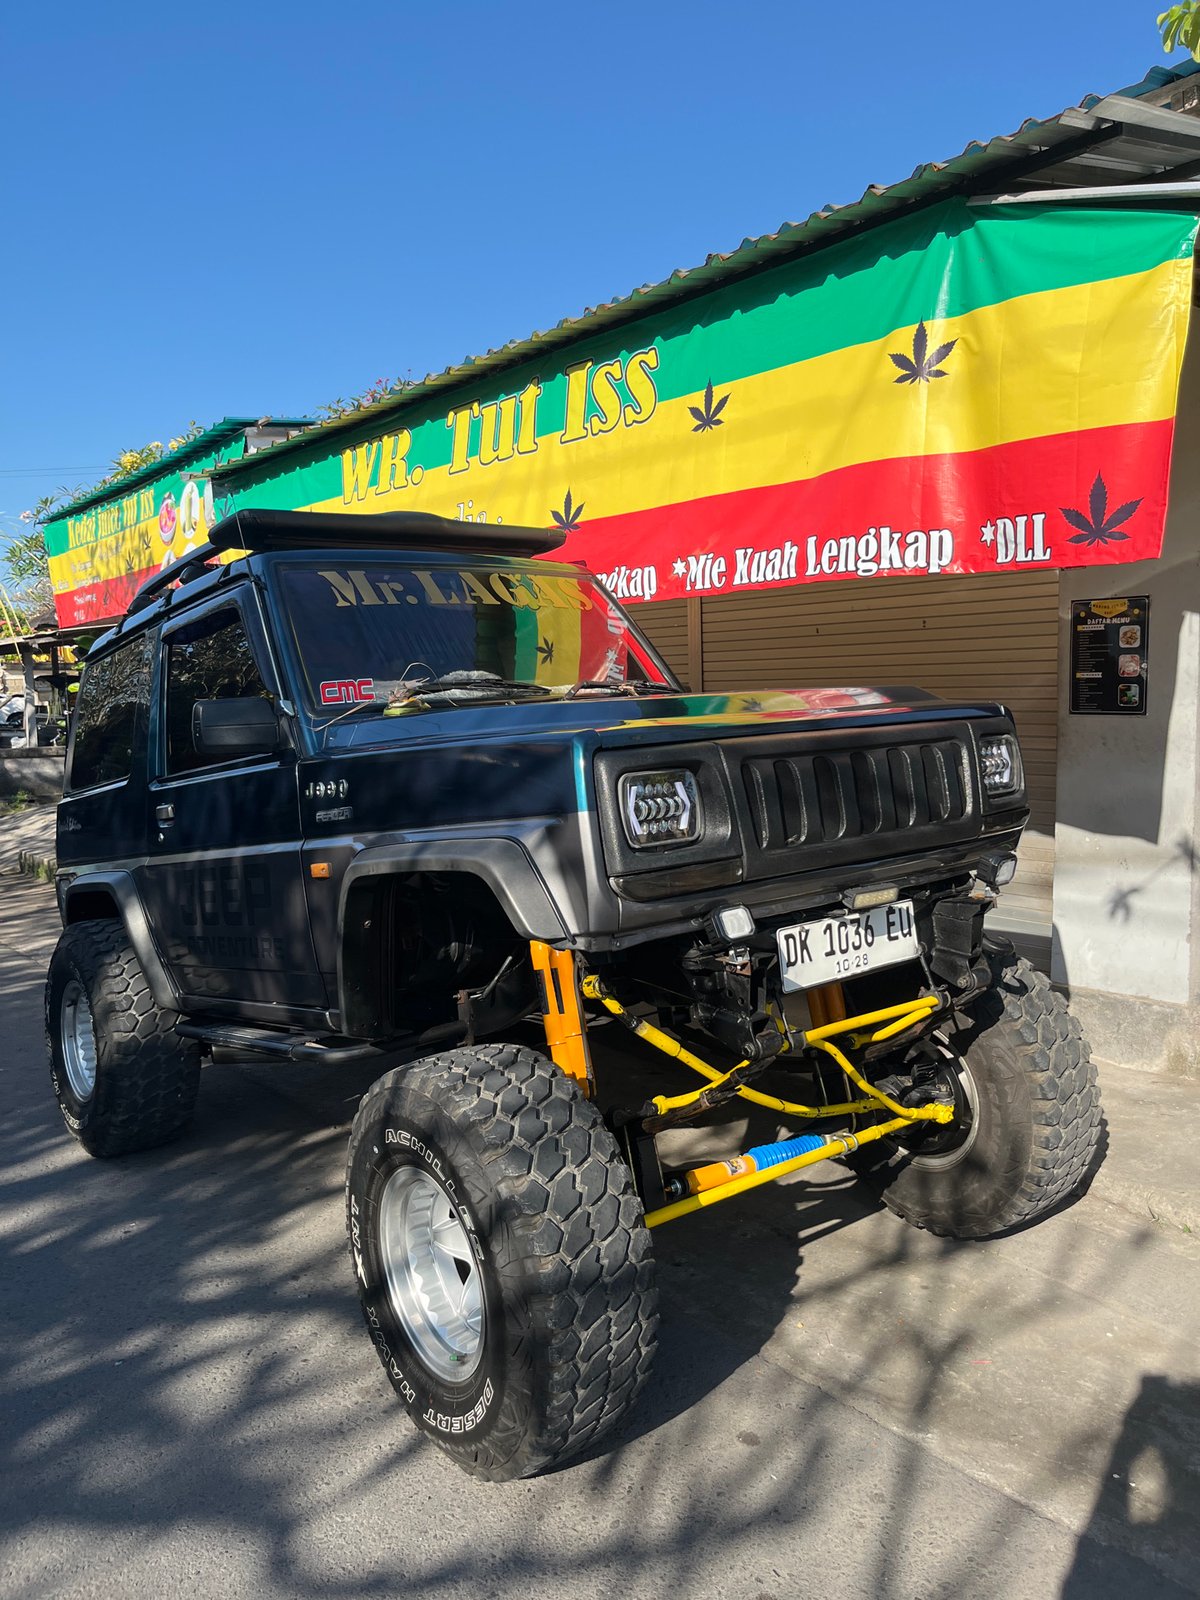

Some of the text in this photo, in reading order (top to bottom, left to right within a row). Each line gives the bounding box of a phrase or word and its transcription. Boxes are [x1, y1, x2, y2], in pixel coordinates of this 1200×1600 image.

[341, 346, 659, 505] WR. Tut ISS
[595, 565, 657, 601] ngkap
[732, 541, 799, 586] Kuah
[805, 526, 954, 577] Lengkap
[320, 678, 376, 705] CMC
[784, 905, 912, 967] DK 1036 EU
[385, 1129, 485, 1261] ACHILLES
[367, 1306, 416, 1403] HAWK
[423, 1377, 494, 1433] DESERT
